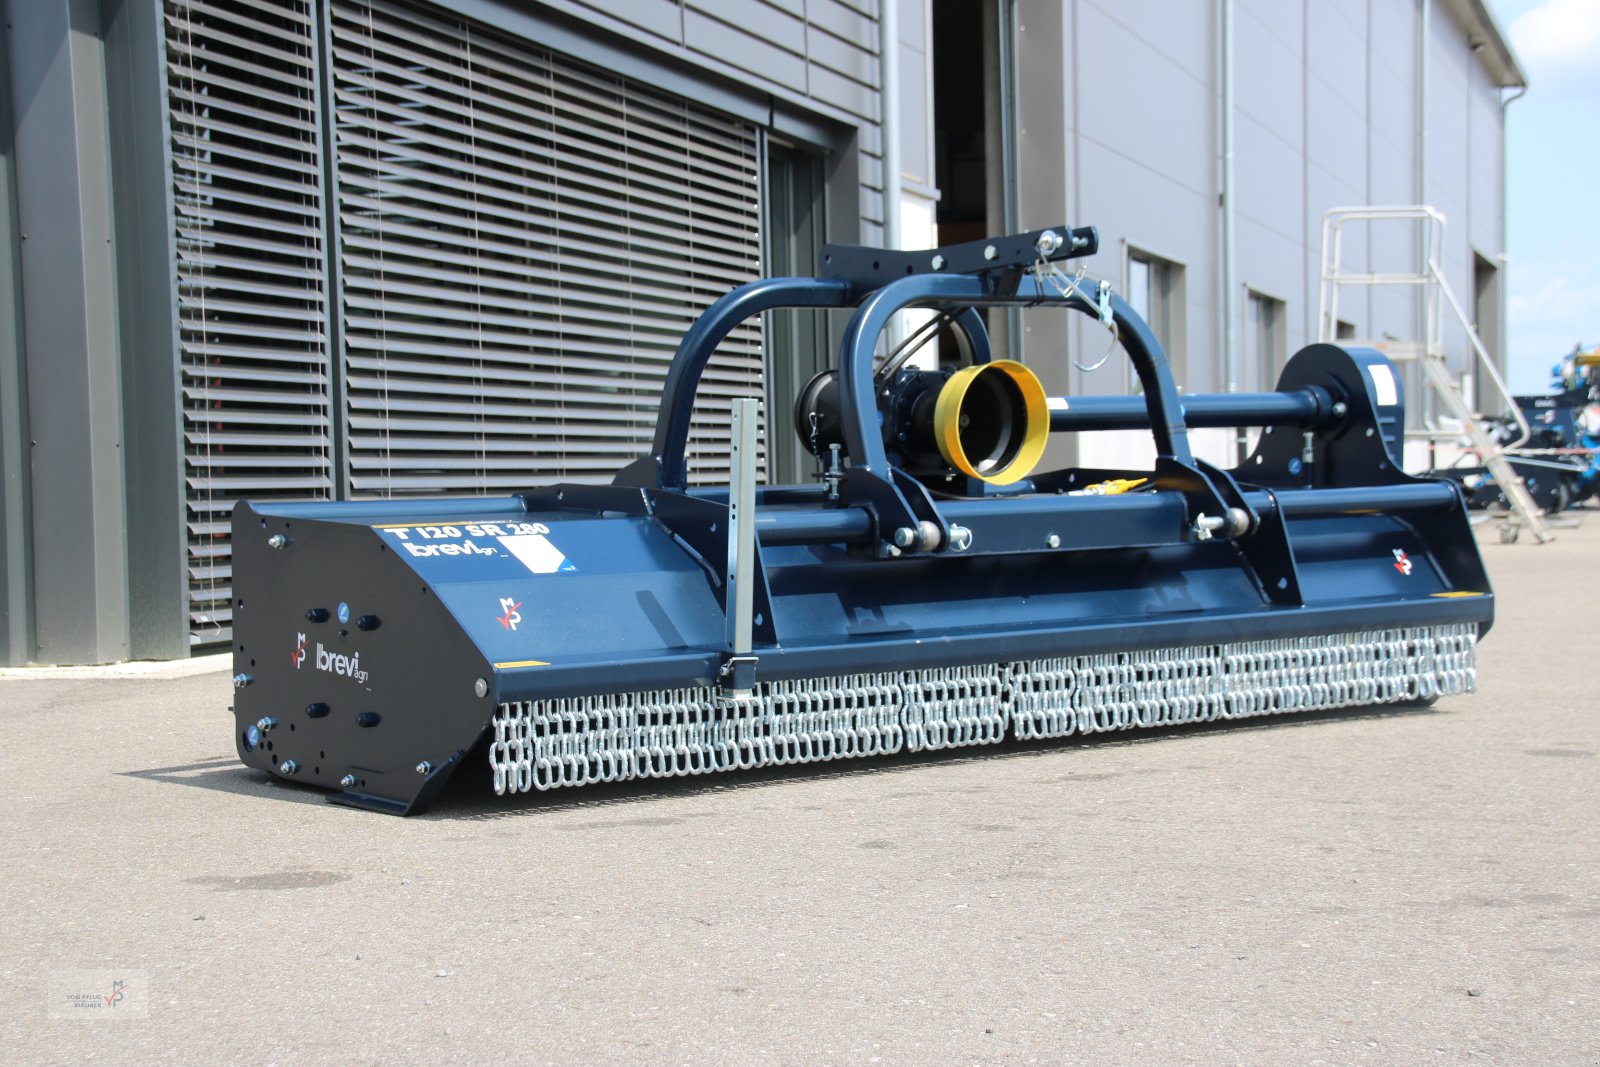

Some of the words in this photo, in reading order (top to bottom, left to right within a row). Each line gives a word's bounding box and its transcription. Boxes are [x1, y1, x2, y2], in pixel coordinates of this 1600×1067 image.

[384, 527, 410, 540] T
[416, 526, 462, 539] 120
[465, 524, 508, 537] SR
[507, 522, 550, 535] 280
[316, 642, 360, 677] brevi
